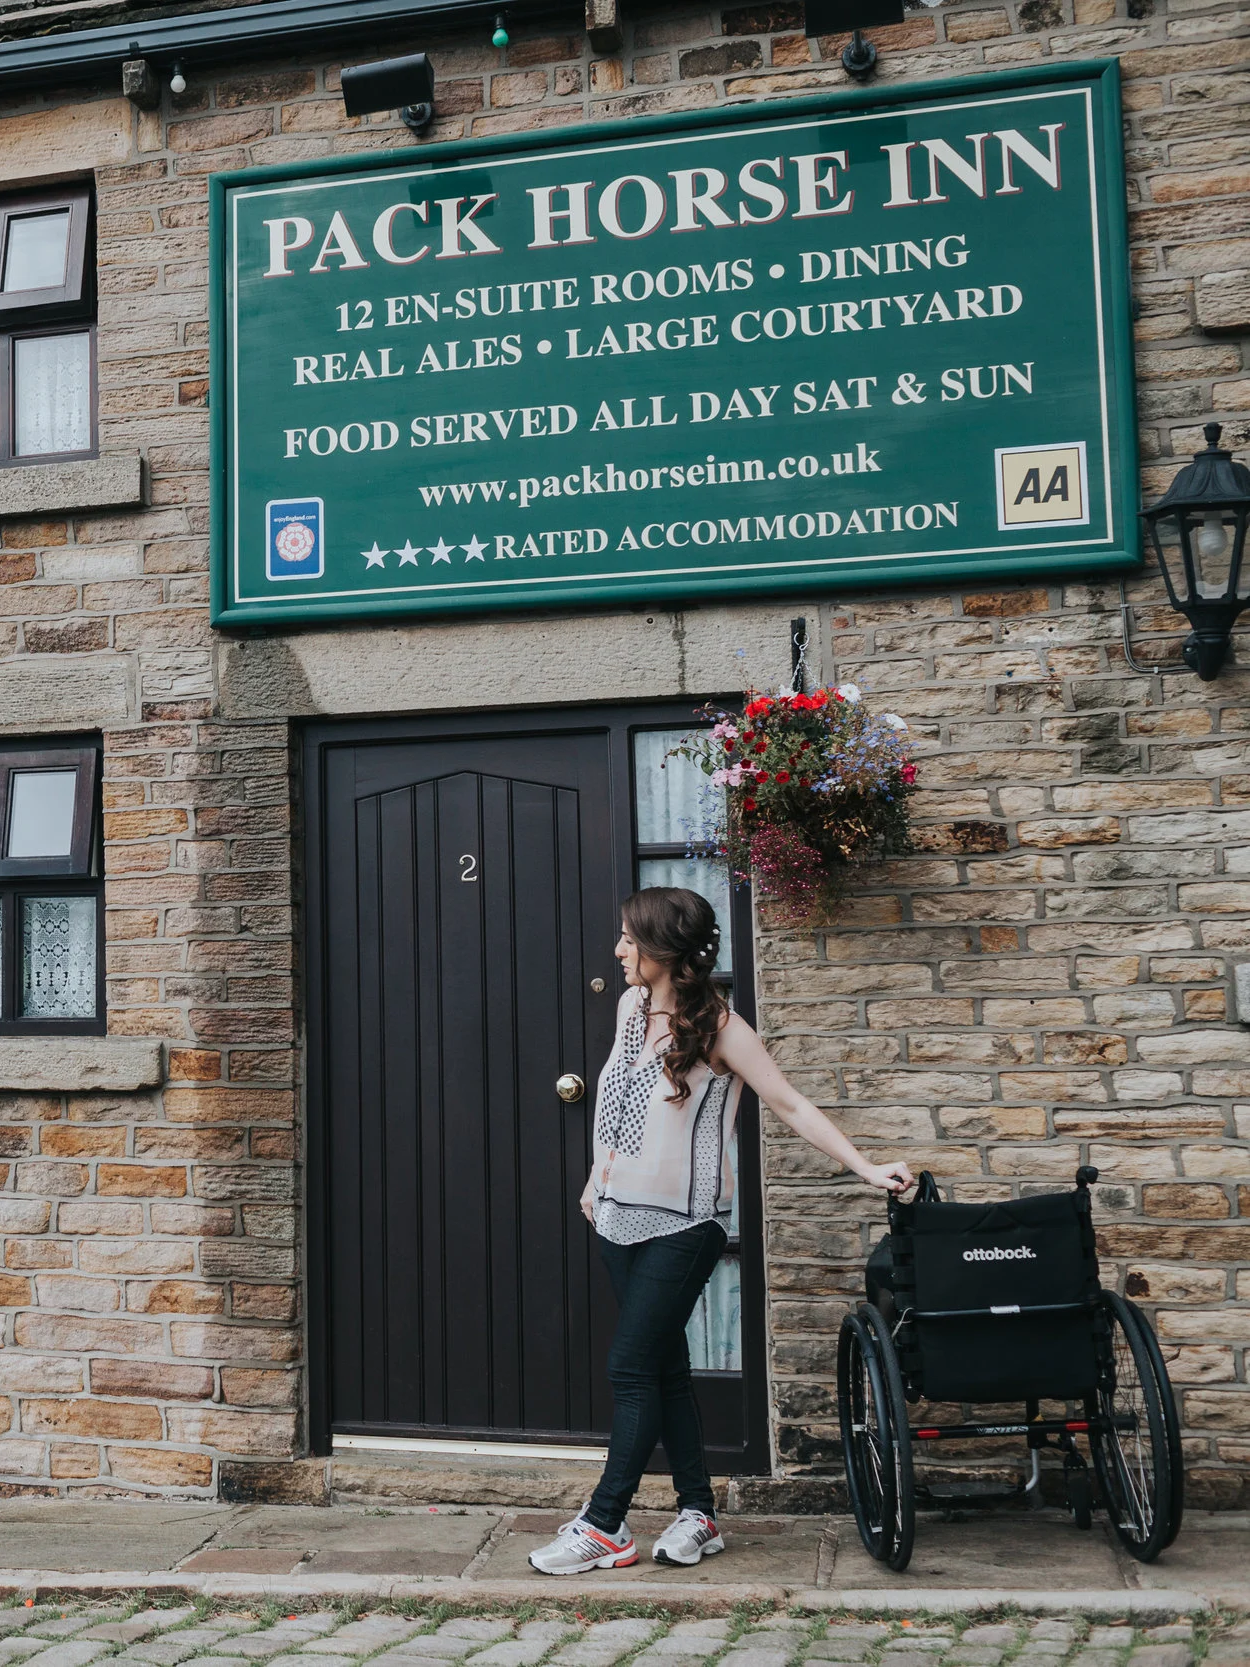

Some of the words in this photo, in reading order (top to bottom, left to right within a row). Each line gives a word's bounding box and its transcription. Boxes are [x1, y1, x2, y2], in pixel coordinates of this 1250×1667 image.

[263, 192, 503, 279] PACK
[526, 150, 855, 249] HORSE
[881, 122, 1066, 208] INN
[336, 300, 374, 332] 12
[385, 277, 580, 327] EN-SUITE
[591, 258, 754, 305] ROOMS
[799, 234, 971, 283] DINING
[293, 347, 404, 386] REAL
[416, 334, 523, 374] ALES
[565, 315, 719, 359] LARGE
[732, 284, 1023, 343] COURTYARD
[284, 420, 400, 459] FOOD
[410, 404, 578, 448] SERVED
[589, 395, 678, 432] ALL
[689, 385, 781, 423] DAY
[793, 376, 877, 415] SAT
[891, 372, 927, 406] &
[941, 361, 1035, 402] SUN
[419, 443, 881, 508] www.packhorseinn.co.uk
[1013, 465, 1069, 505] AA
[493, 527, 609, 560] RATED
[615, 501, 959, 552] ACCOMMODATION
[459, 854, 477, 881] 2
